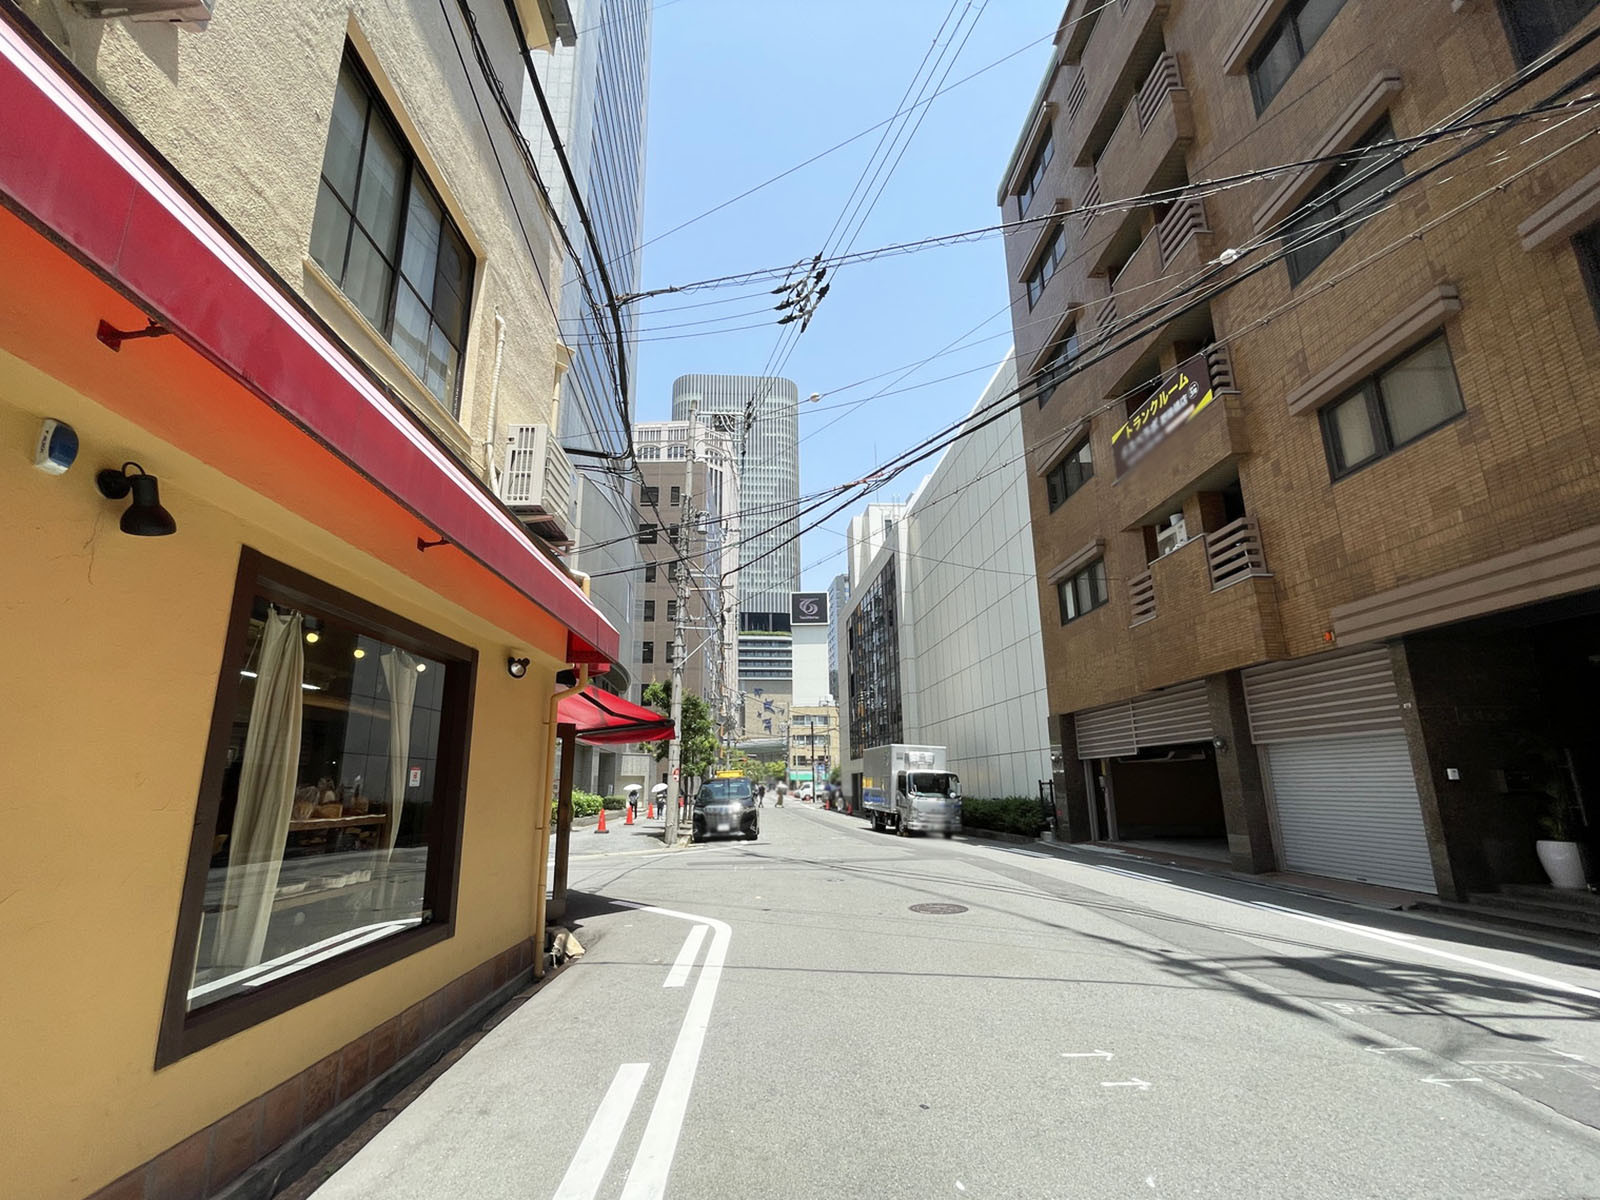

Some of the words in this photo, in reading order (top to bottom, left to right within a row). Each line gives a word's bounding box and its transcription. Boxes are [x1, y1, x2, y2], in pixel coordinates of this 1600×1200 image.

[1126, 373, 1189, 440] トランクルーム
